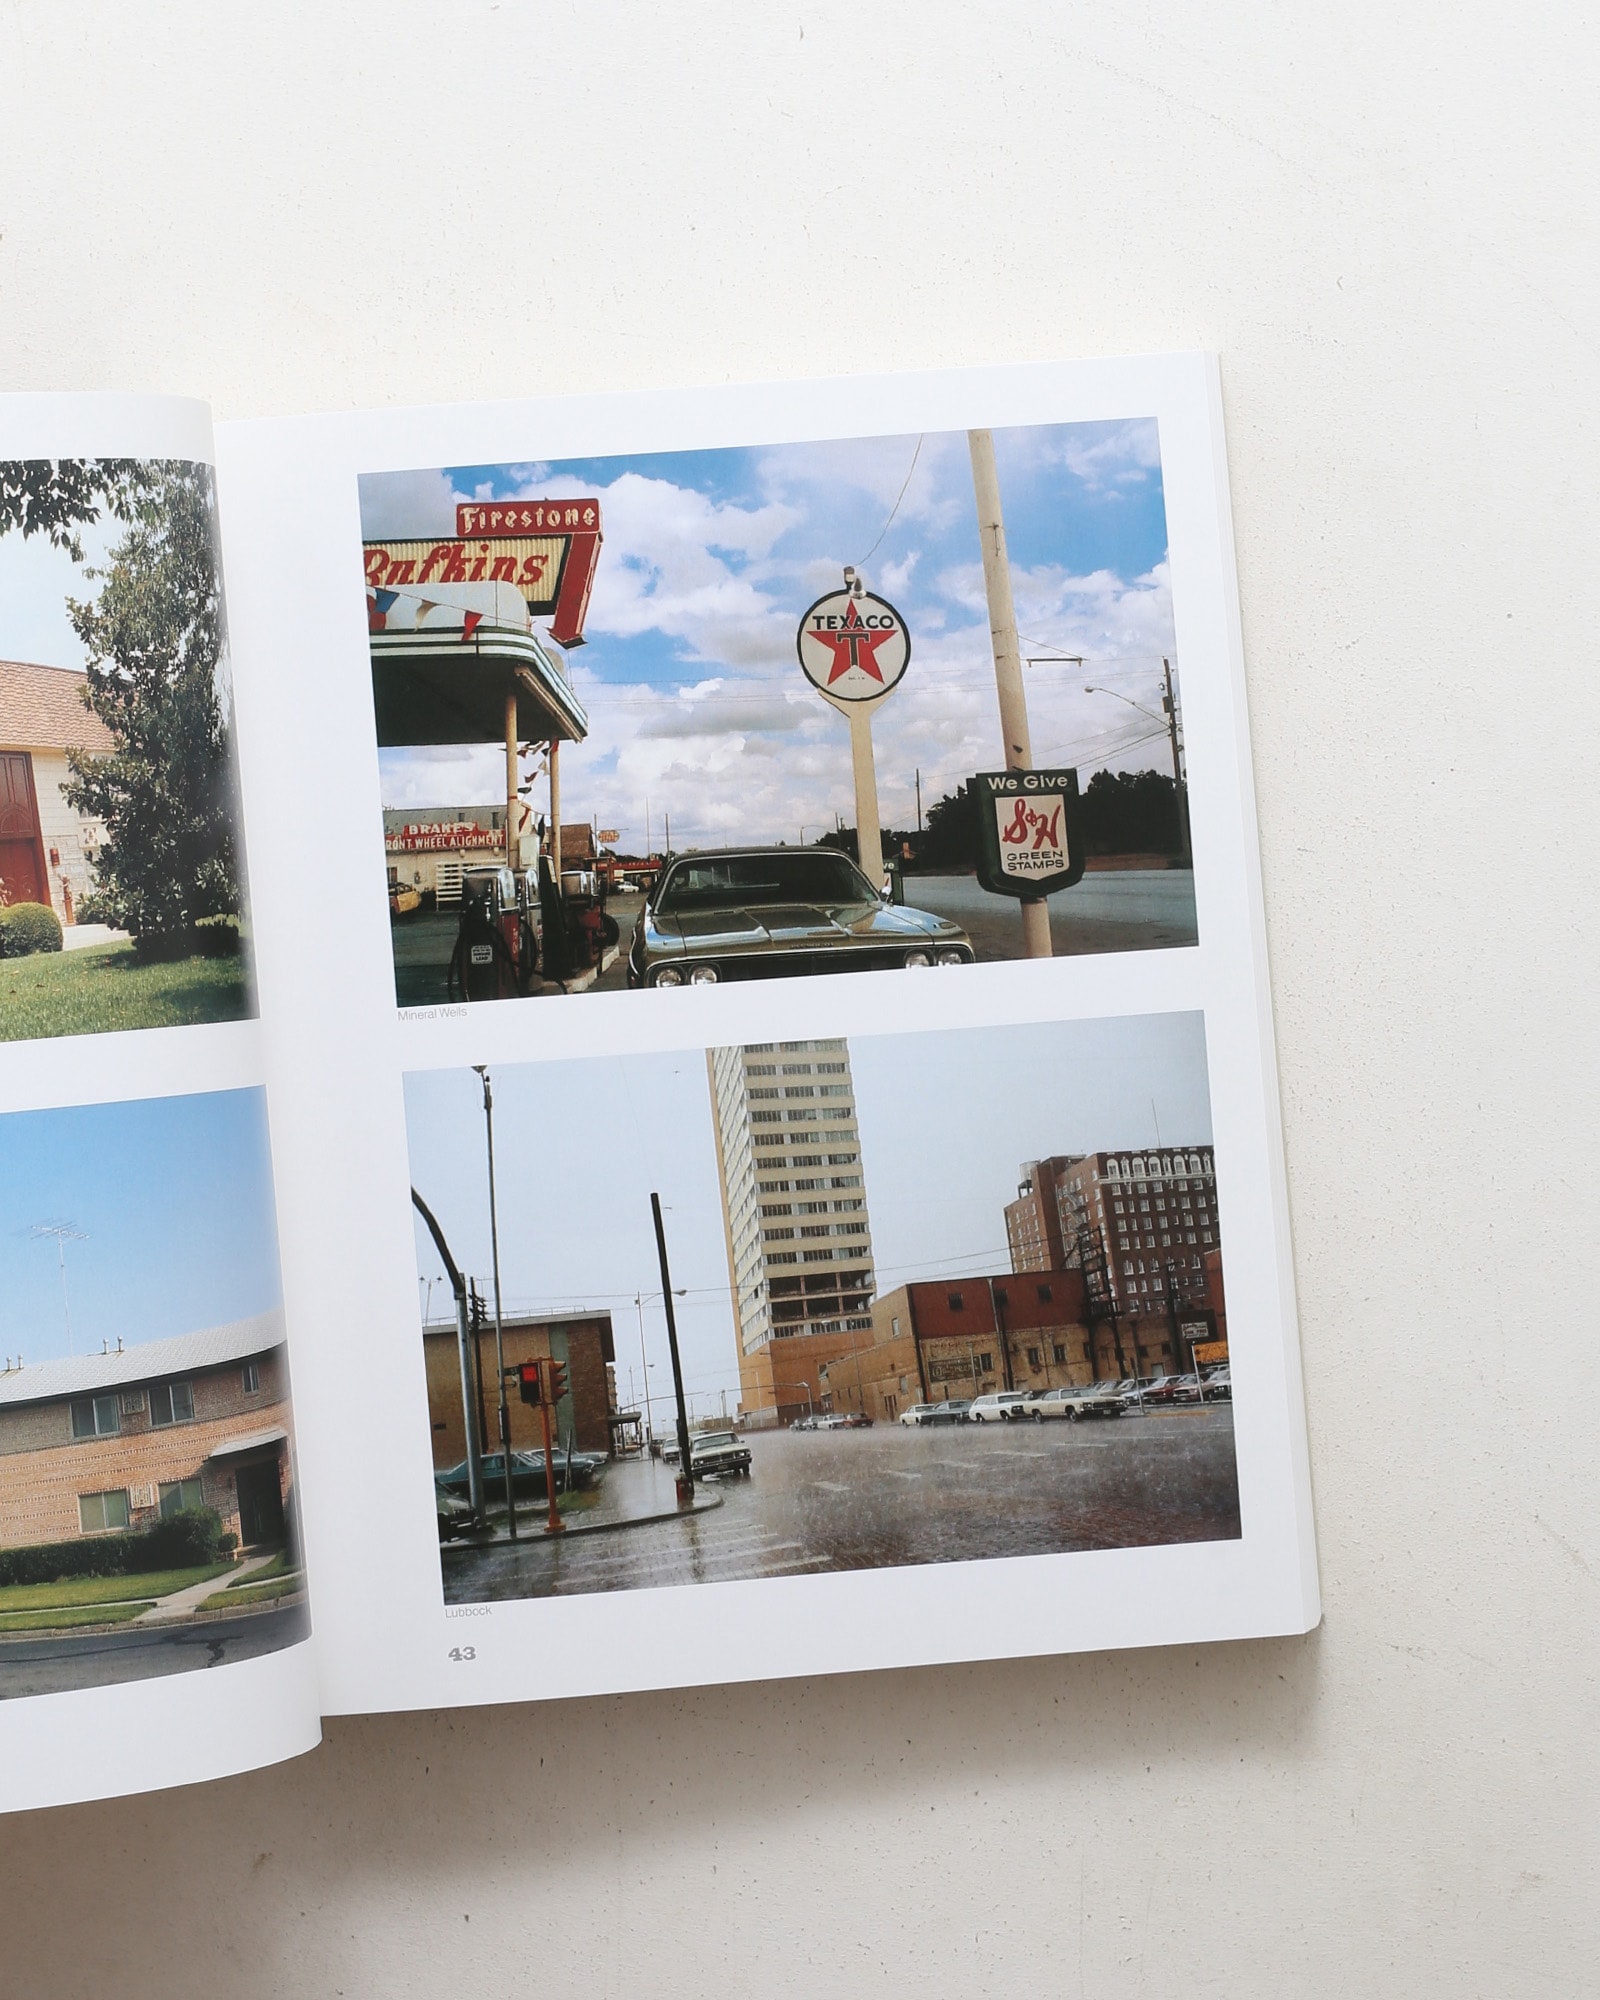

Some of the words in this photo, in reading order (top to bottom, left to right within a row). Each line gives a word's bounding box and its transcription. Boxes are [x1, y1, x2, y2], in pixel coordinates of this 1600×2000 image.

[460, 504, 596, 533] Firestone
[812, 615, 895, 630] TEXACO
[836, 632, 870, 666] T
[987, 777, 1018, 790] We
[1023, 774, 1069, 788] Give
[409, 822, 476, 835] BRAKES
[1002, 798, 1062, 850] S&H
[414, 836, 447, 849] WHEEL
[449, 834, 504, 848] ALIGNMENT
[1006, 851, 1064, 862] GREEN
[1007, 859, 1065, 871] STAMPS
[397, 1008, 437, 1021] Mineral
[439, 1006, 468, 1018] Wells
[445, 1605, 493, 1619] Lubbock
[448, 1646, 477, 1662] 43
